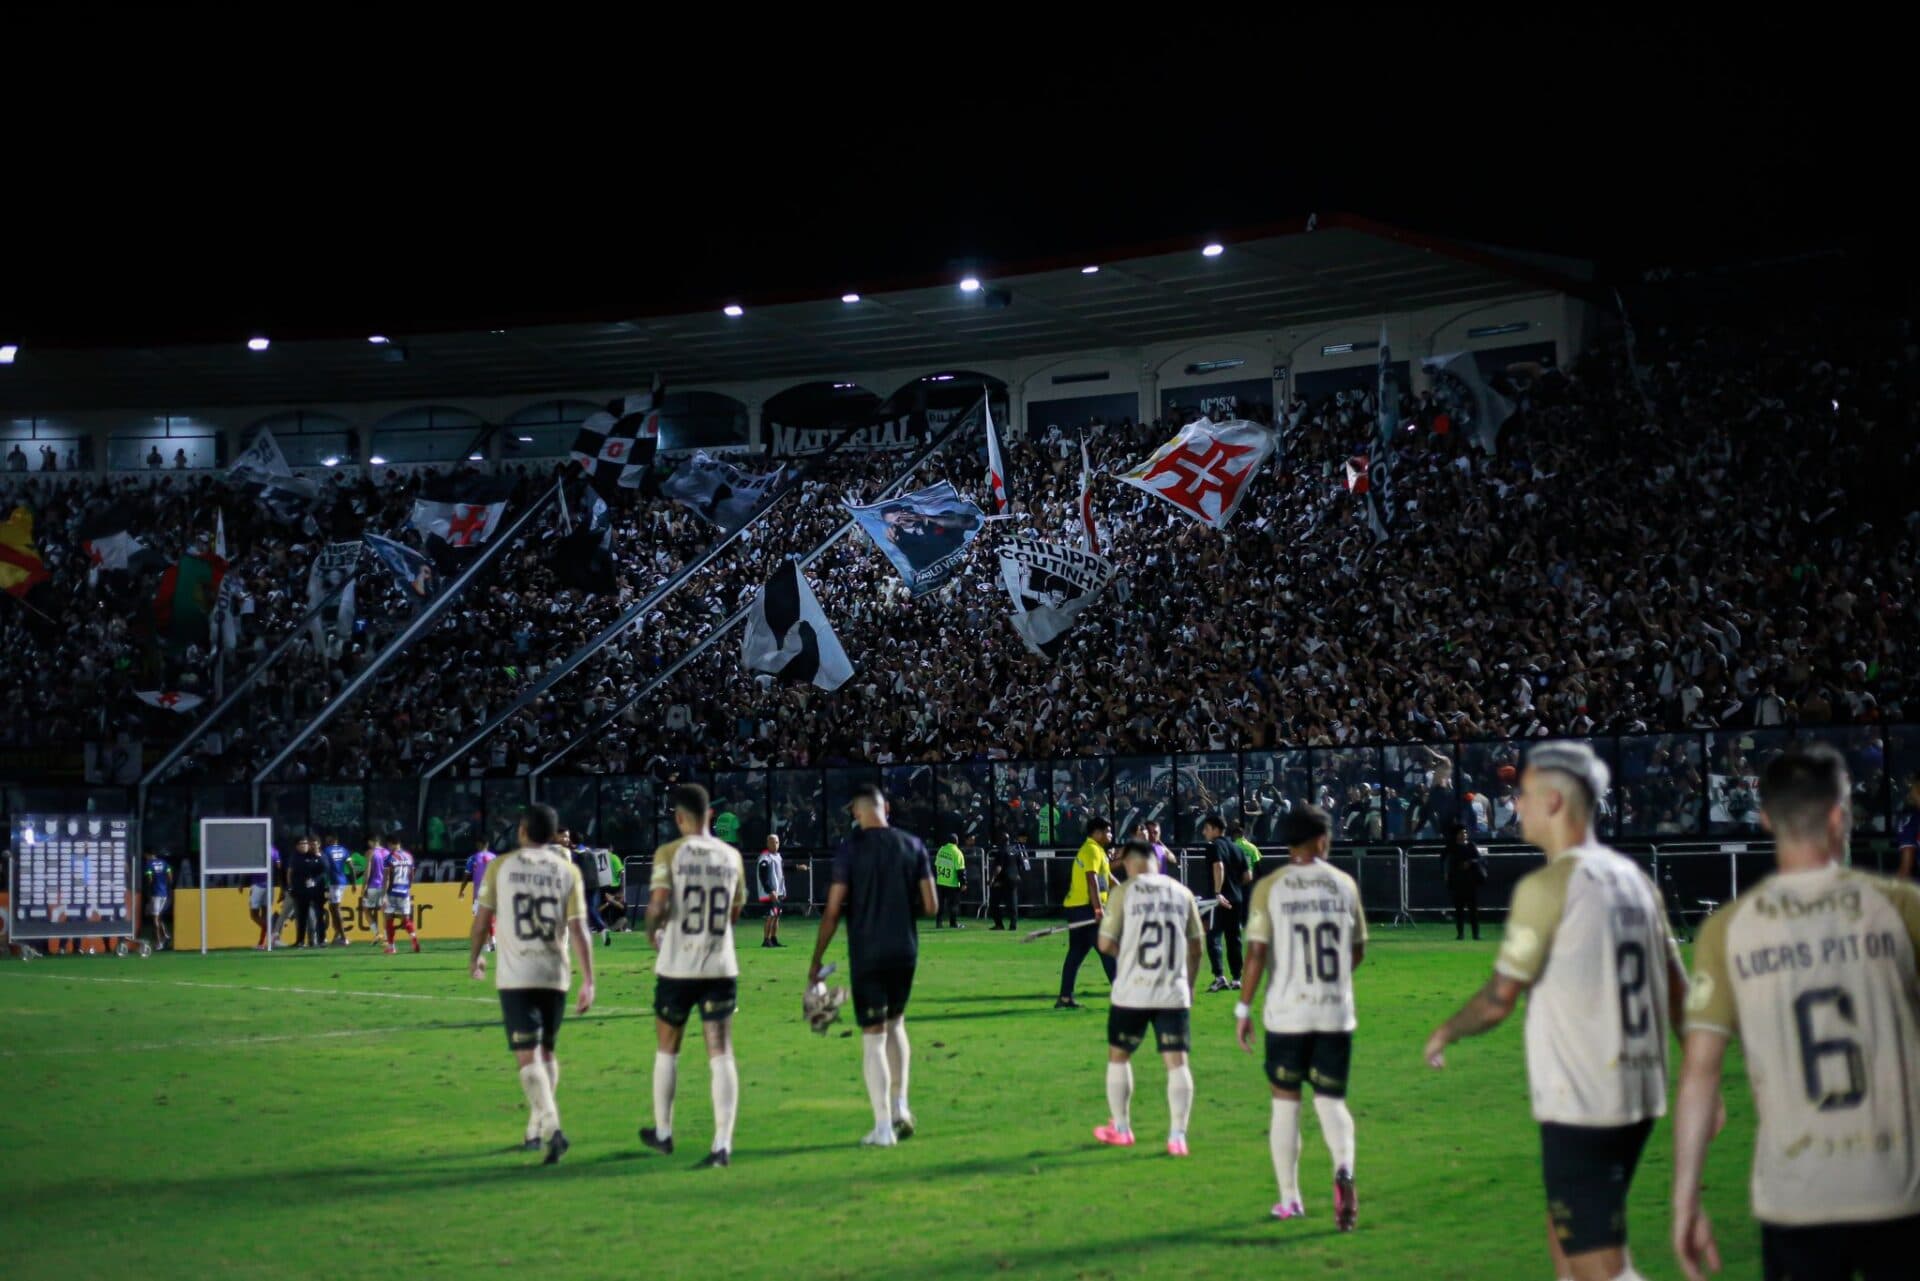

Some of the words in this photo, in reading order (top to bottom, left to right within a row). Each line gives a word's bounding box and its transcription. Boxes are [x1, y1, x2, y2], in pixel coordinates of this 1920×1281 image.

[1001, 536, 1108, 581] PHILIPPE
[513, 892, 558, 942] 85
[682, 885, 731, 936] 38
[1138, 920, 1176, 971] 21
[1294, 921, 1341, 985] 16
[1735, 942, 1813, 979] LUCAS
[1821, 930, 1896, 963] PITON
[1616, 940, 1649, 1038] 2
[1794, 986, 1868, 1113] 6
